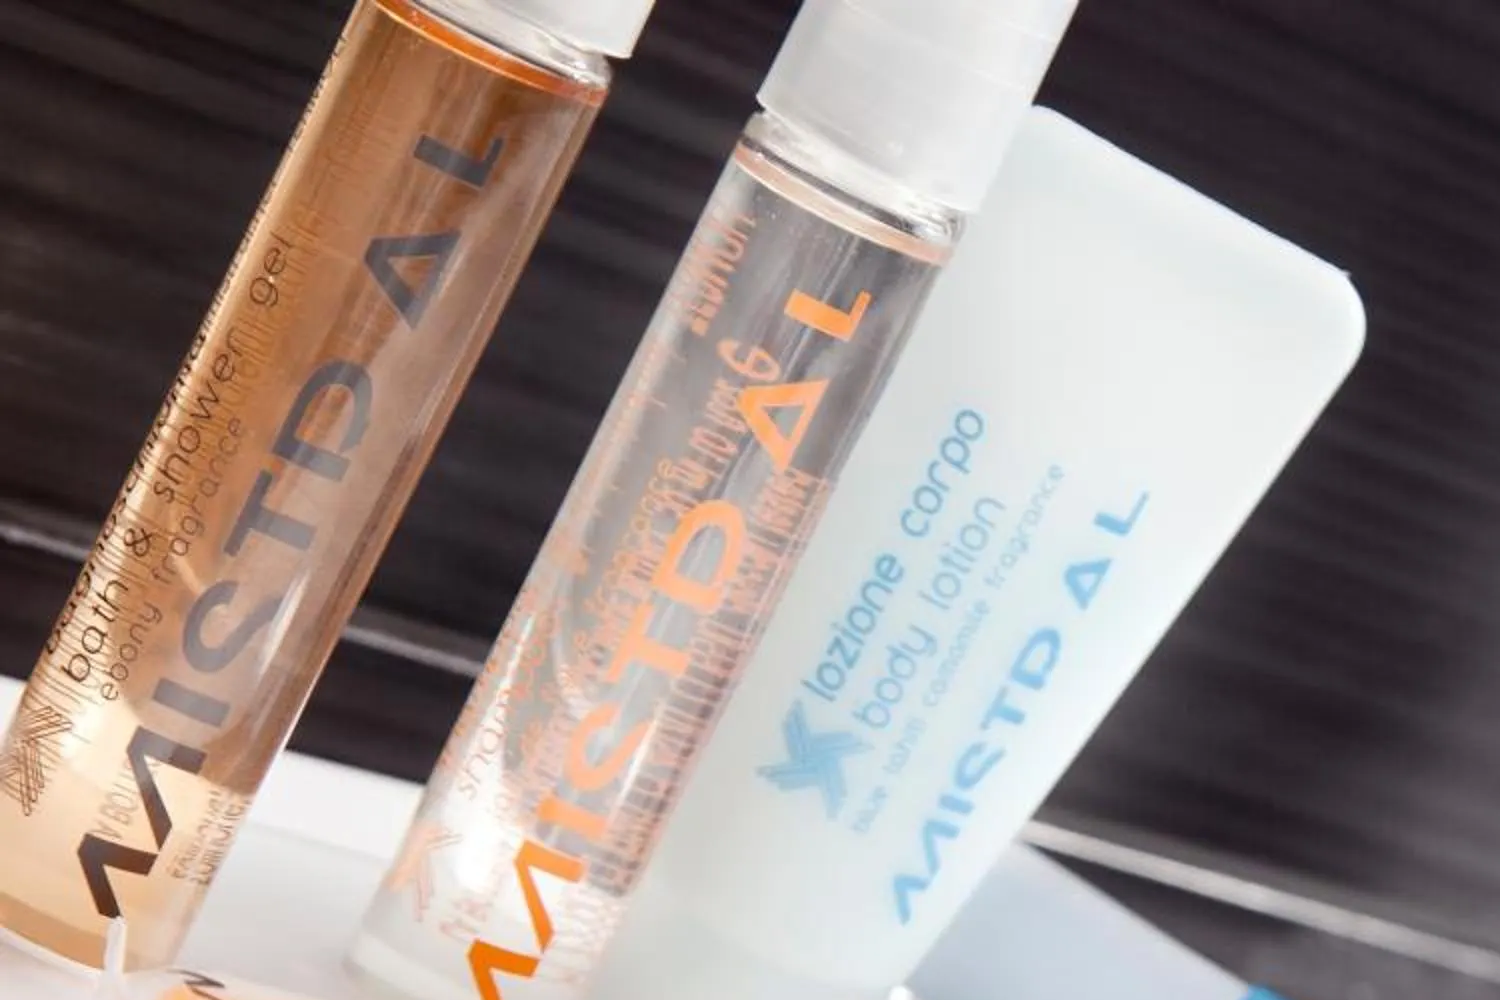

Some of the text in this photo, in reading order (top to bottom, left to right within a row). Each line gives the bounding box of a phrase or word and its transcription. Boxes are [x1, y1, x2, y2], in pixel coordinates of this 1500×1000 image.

[62, 232, 294, 684] bath & shower gel
[102, 599, 162, 702] ebony
[152, 417, 246, 586] fragrance
[801, 408, 984, 701] lozione corpo
[985, 463, 1066, 588] fragrance
[853, 494, 1006, 730] body lotion
